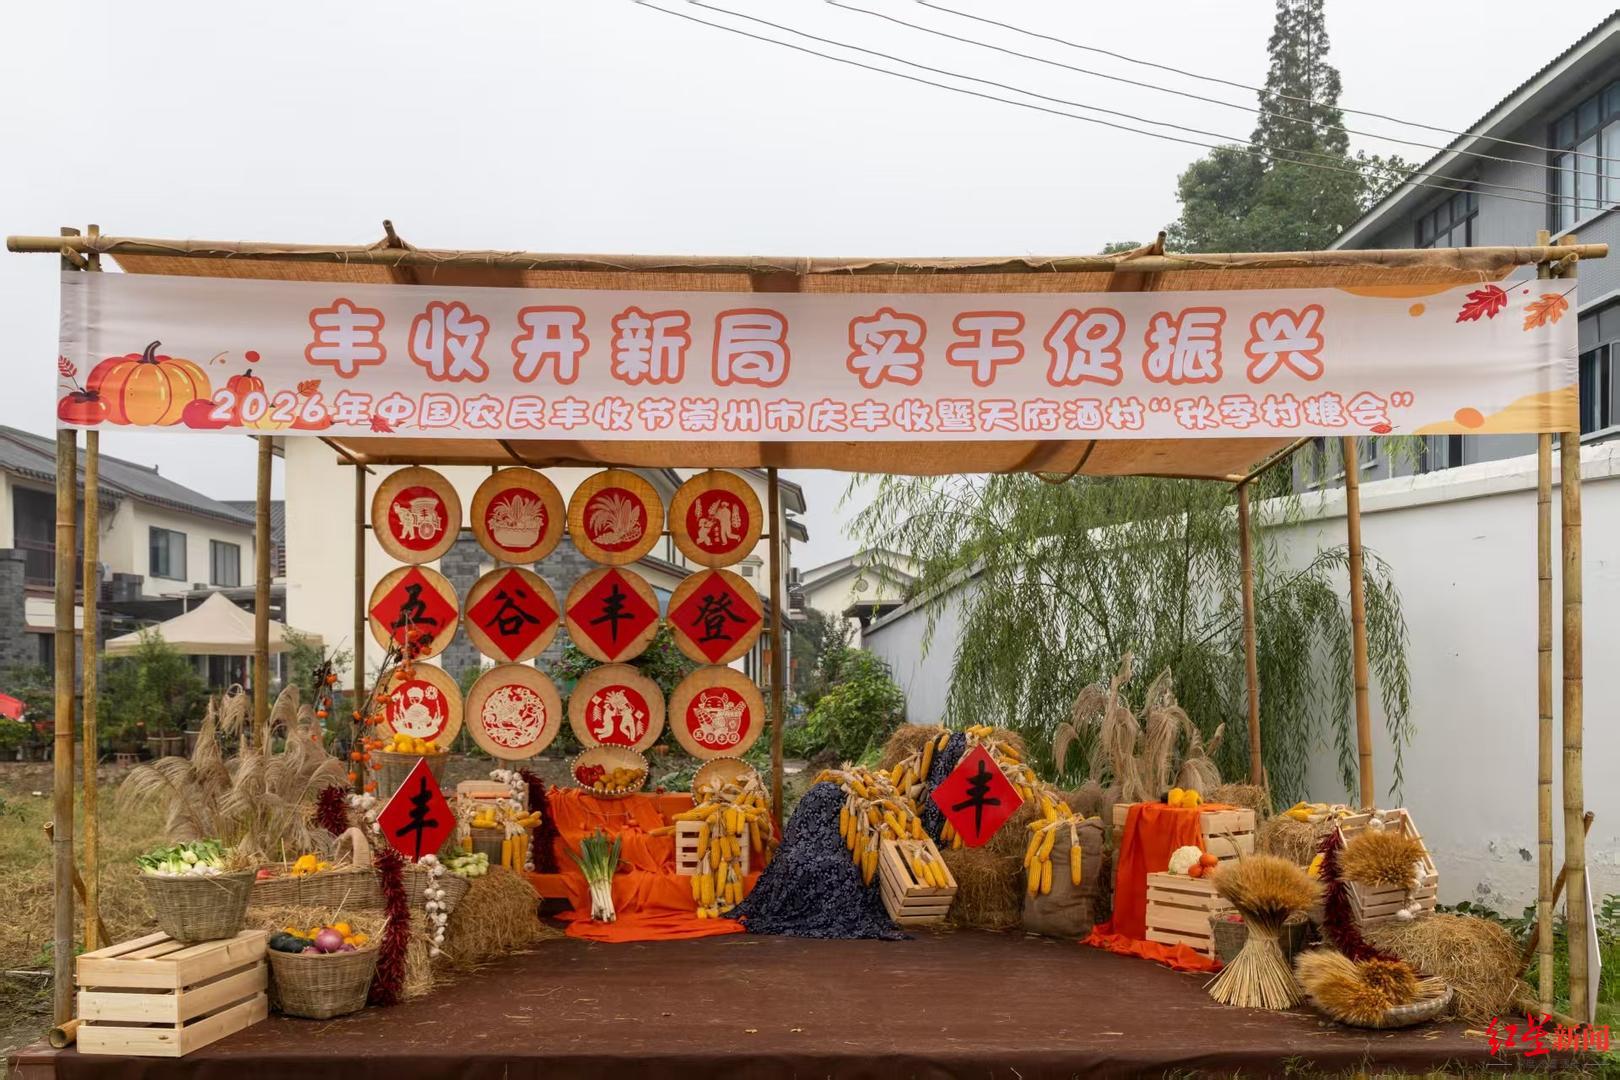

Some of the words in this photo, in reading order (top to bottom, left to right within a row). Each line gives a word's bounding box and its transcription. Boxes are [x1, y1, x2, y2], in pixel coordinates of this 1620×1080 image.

[305, 298, 791, 388] 丰收开新局
[846, 303, 1325, 389] 实干促振兴
[391, 583, 437, 629] 五
[486, 590, 541, 636] 谷
[590, 583, 636, 644] 丰
[691, 592, 748, 643] 登
[396, 776, 439, 864] 丰
[951, 759, 1002, 839] 丰
